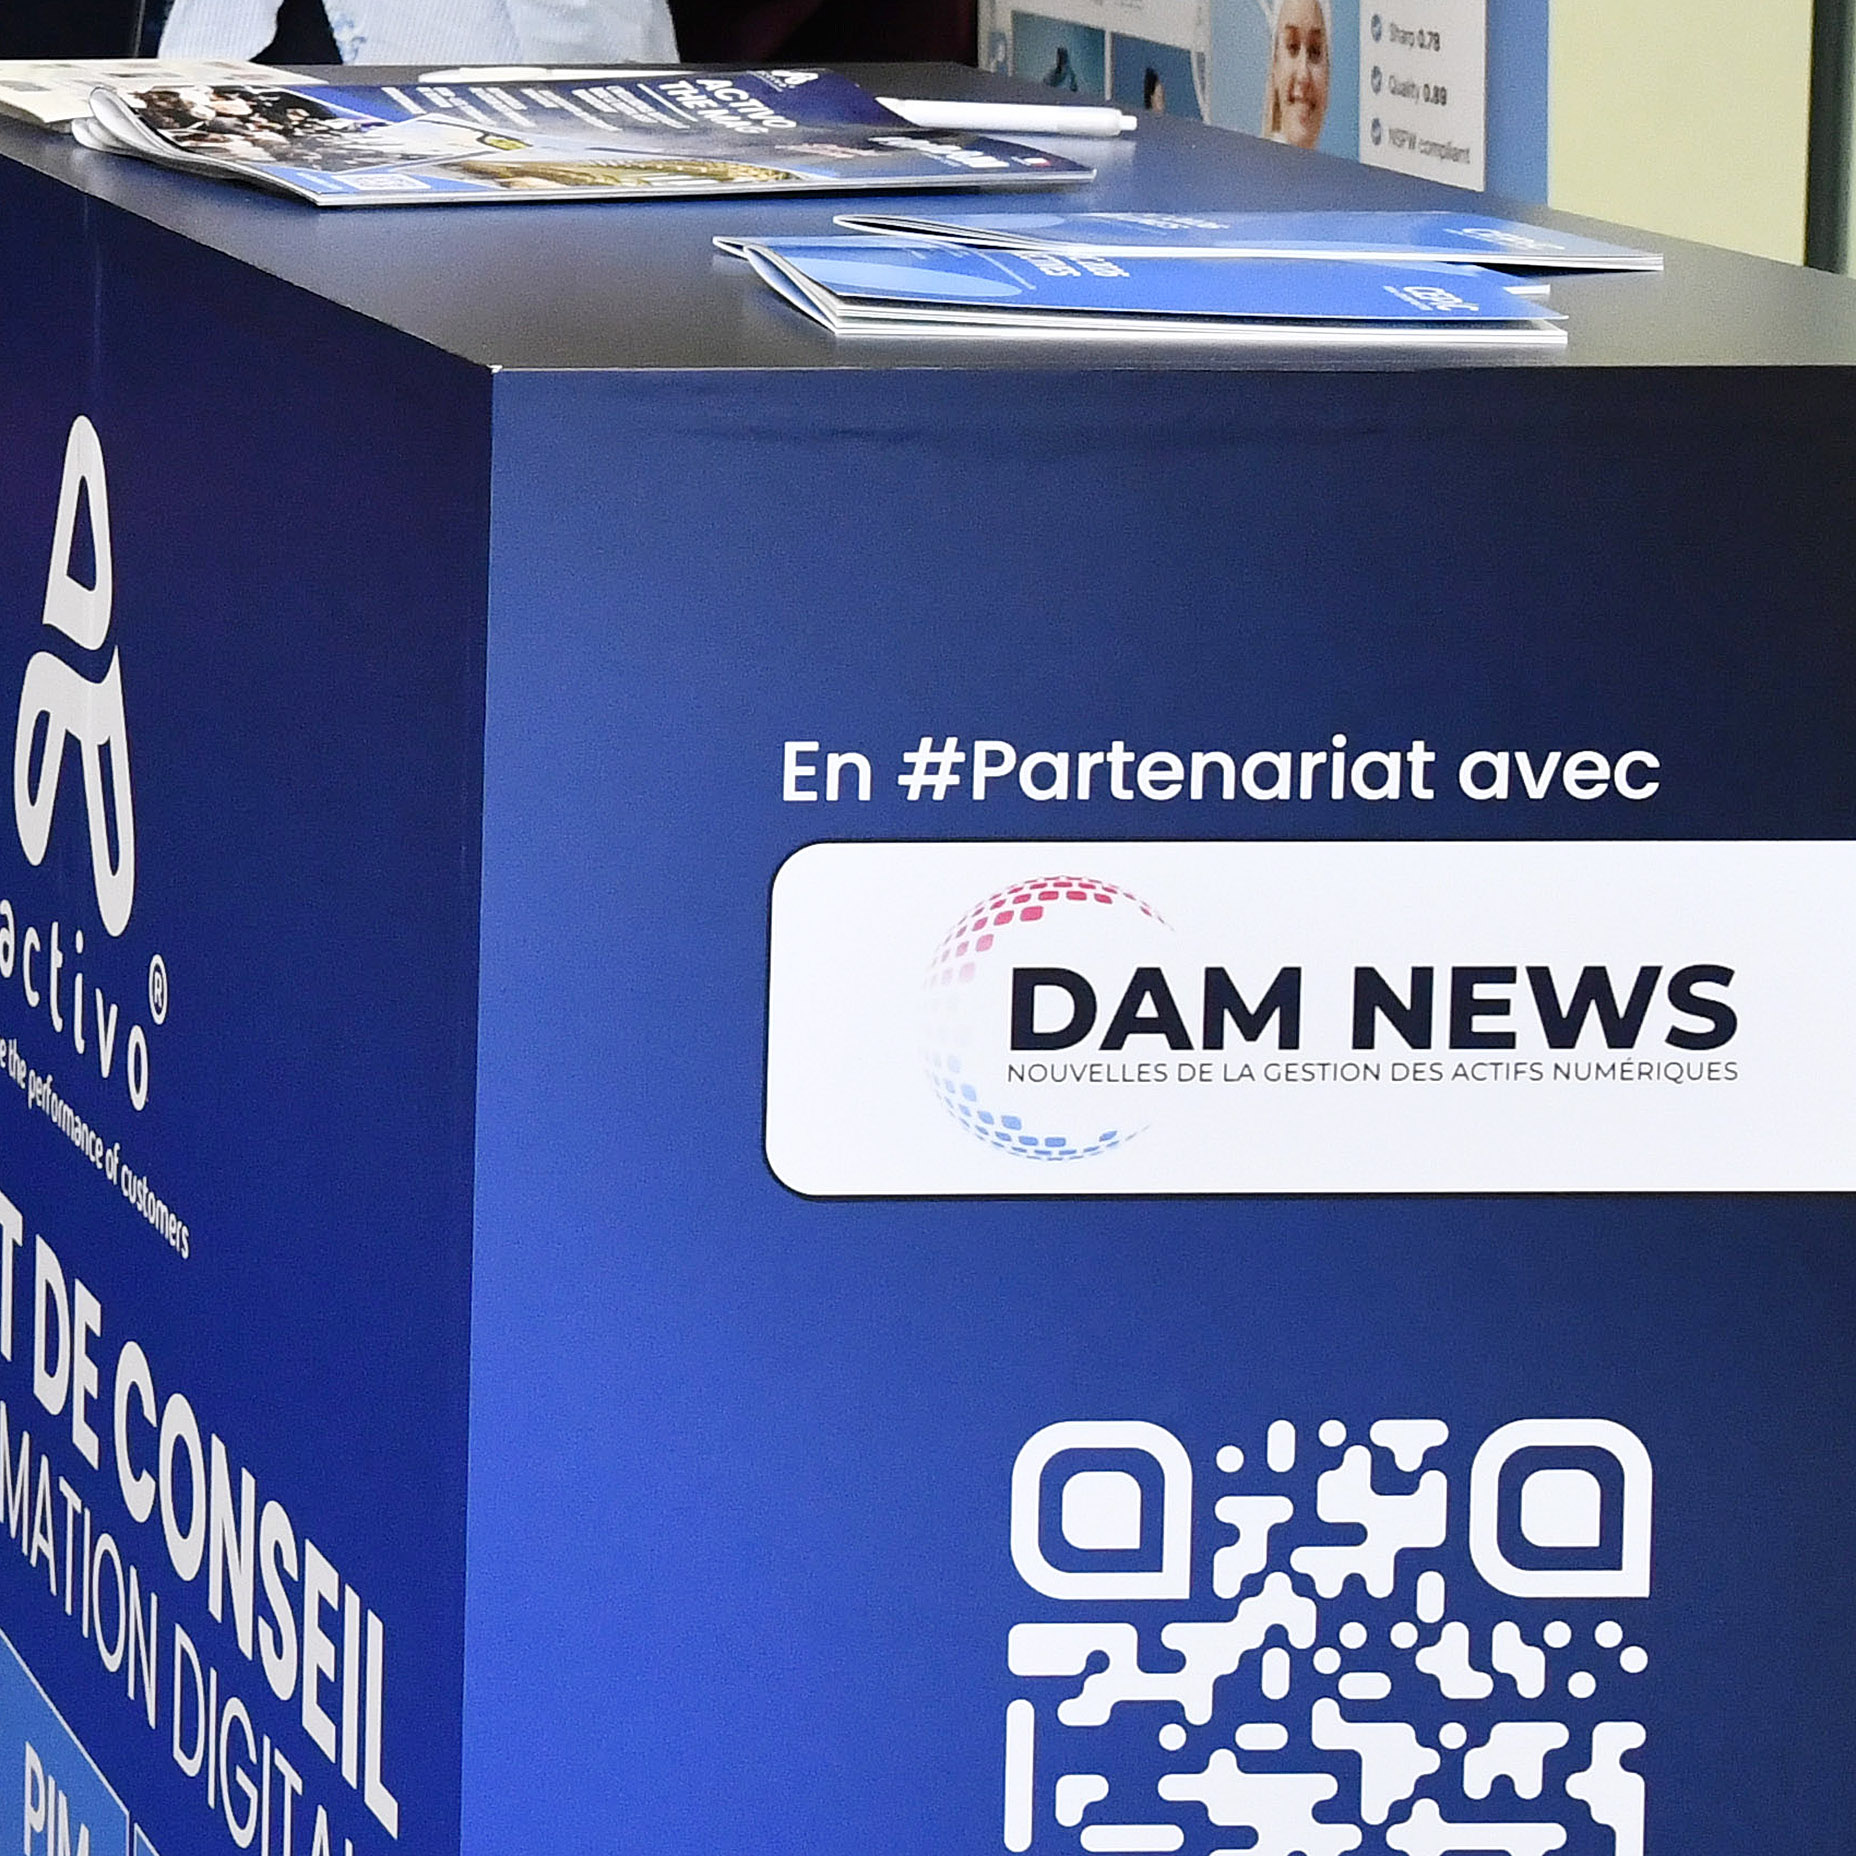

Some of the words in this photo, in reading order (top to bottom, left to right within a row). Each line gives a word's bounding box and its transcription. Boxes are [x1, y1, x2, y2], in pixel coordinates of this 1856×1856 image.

[658, 80, 719, 109] THE
[695, 78, 797, 129] ACTIVO
[781, 741, 872, 802] En
[897, 734, 1438, 803] #Partenariat
[1458, 749, 1661, 802] avec
[1010, 966, 1302, 1052] DAM
[1351, 963, 1739, 1052] NEWS
[1007, 1062, 1169, 1084] NOUVELLES
[1175, 1062, 1218, 1084] DE
[1223, 1062, 1257, 1084] LA
[1263, 1062, 1380, 1084] GESTION
[1391, 1062, 1443, 1084] DES
[1451, 1062, 1544, 1084] ACTIFS
[1553, 1057, 1740, 1085] NUMÉRIQUES
[7, 1038, 26, 1089] the
[28, 1068, 103, 1170] performance
[105, 1142, 120, 1185] of
[121, 1162, 189, 1260] customers
[32, 1233, 102, 1469] DE
[114, 1341, 399, 1840] CONSEIL
[173, 1622, 355, 1856] DIGIT
